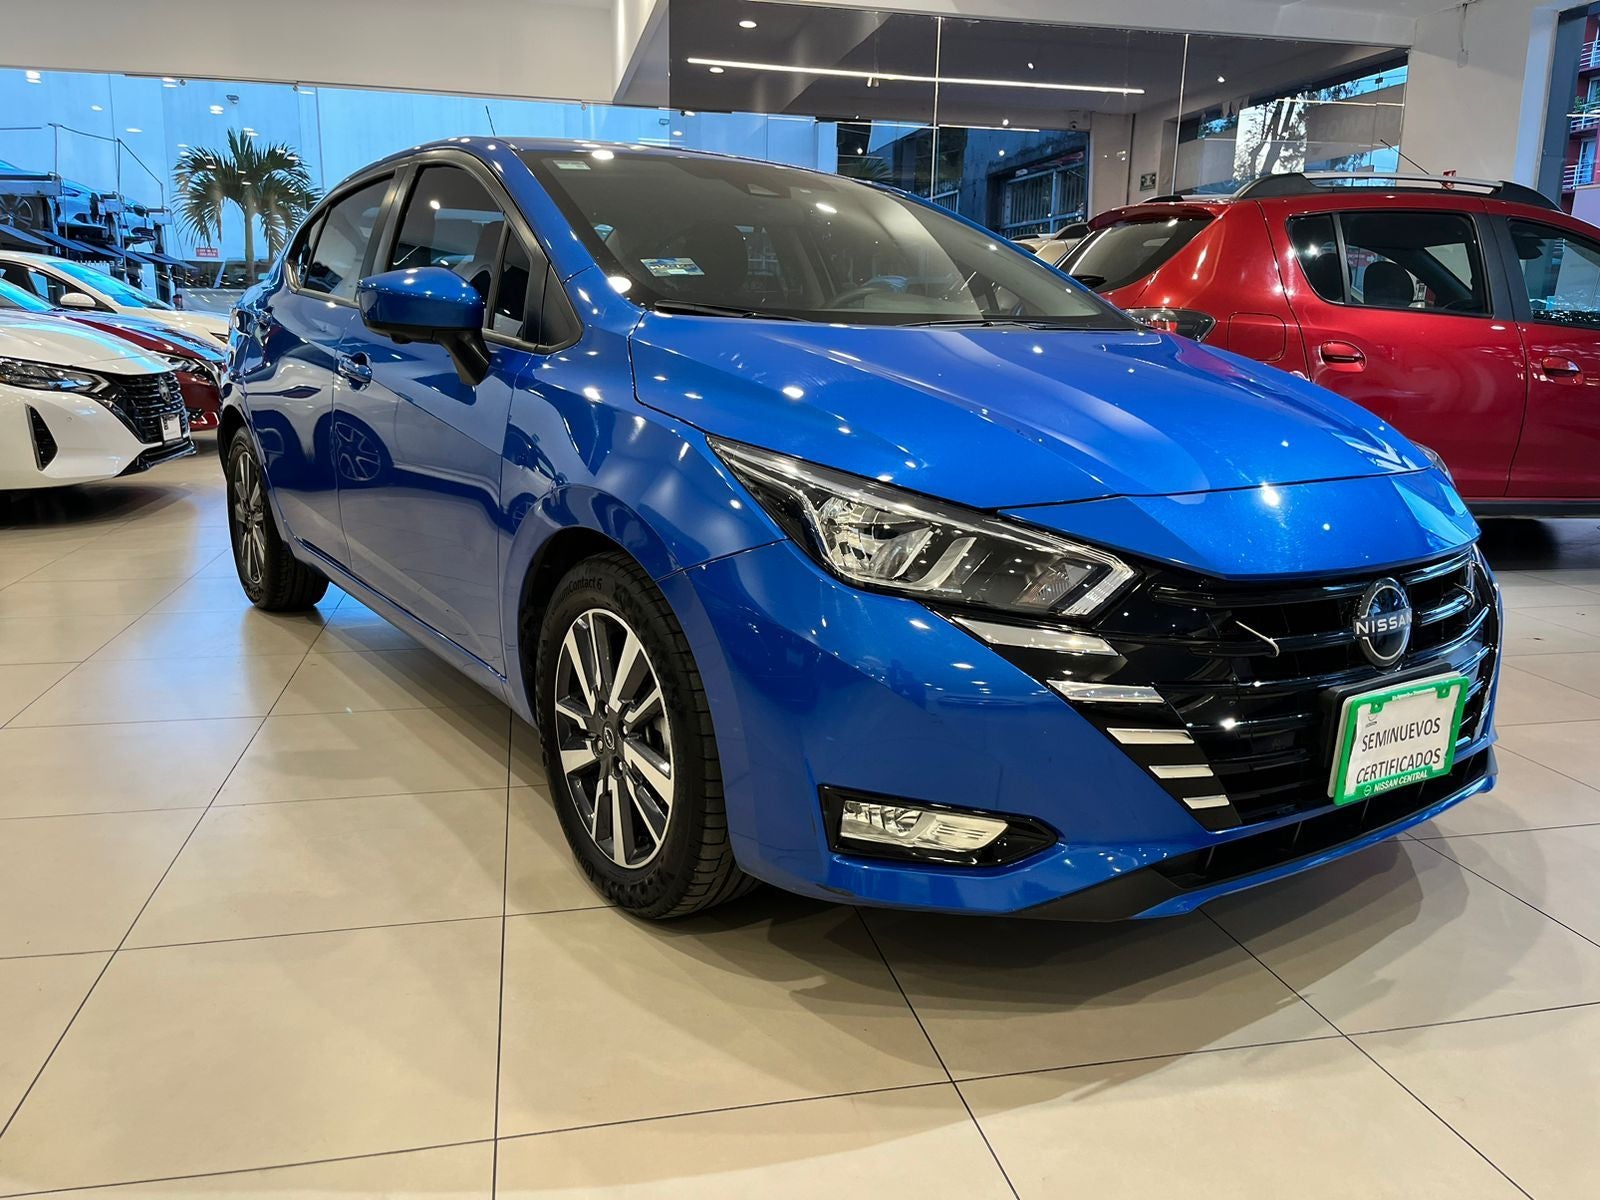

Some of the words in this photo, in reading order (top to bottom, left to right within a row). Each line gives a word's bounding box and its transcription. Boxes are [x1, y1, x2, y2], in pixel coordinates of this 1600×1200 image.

[1355, 611, 1412, 635] NISSAN
[1361, 717, 1441, 752] SEMINUEVOS
[1356, 747, 1441, 784] CERTIFICADOS
[1373, 778, 1399, 792] NISSAN
[1398, 769, 1428, 785] CENTRAL
